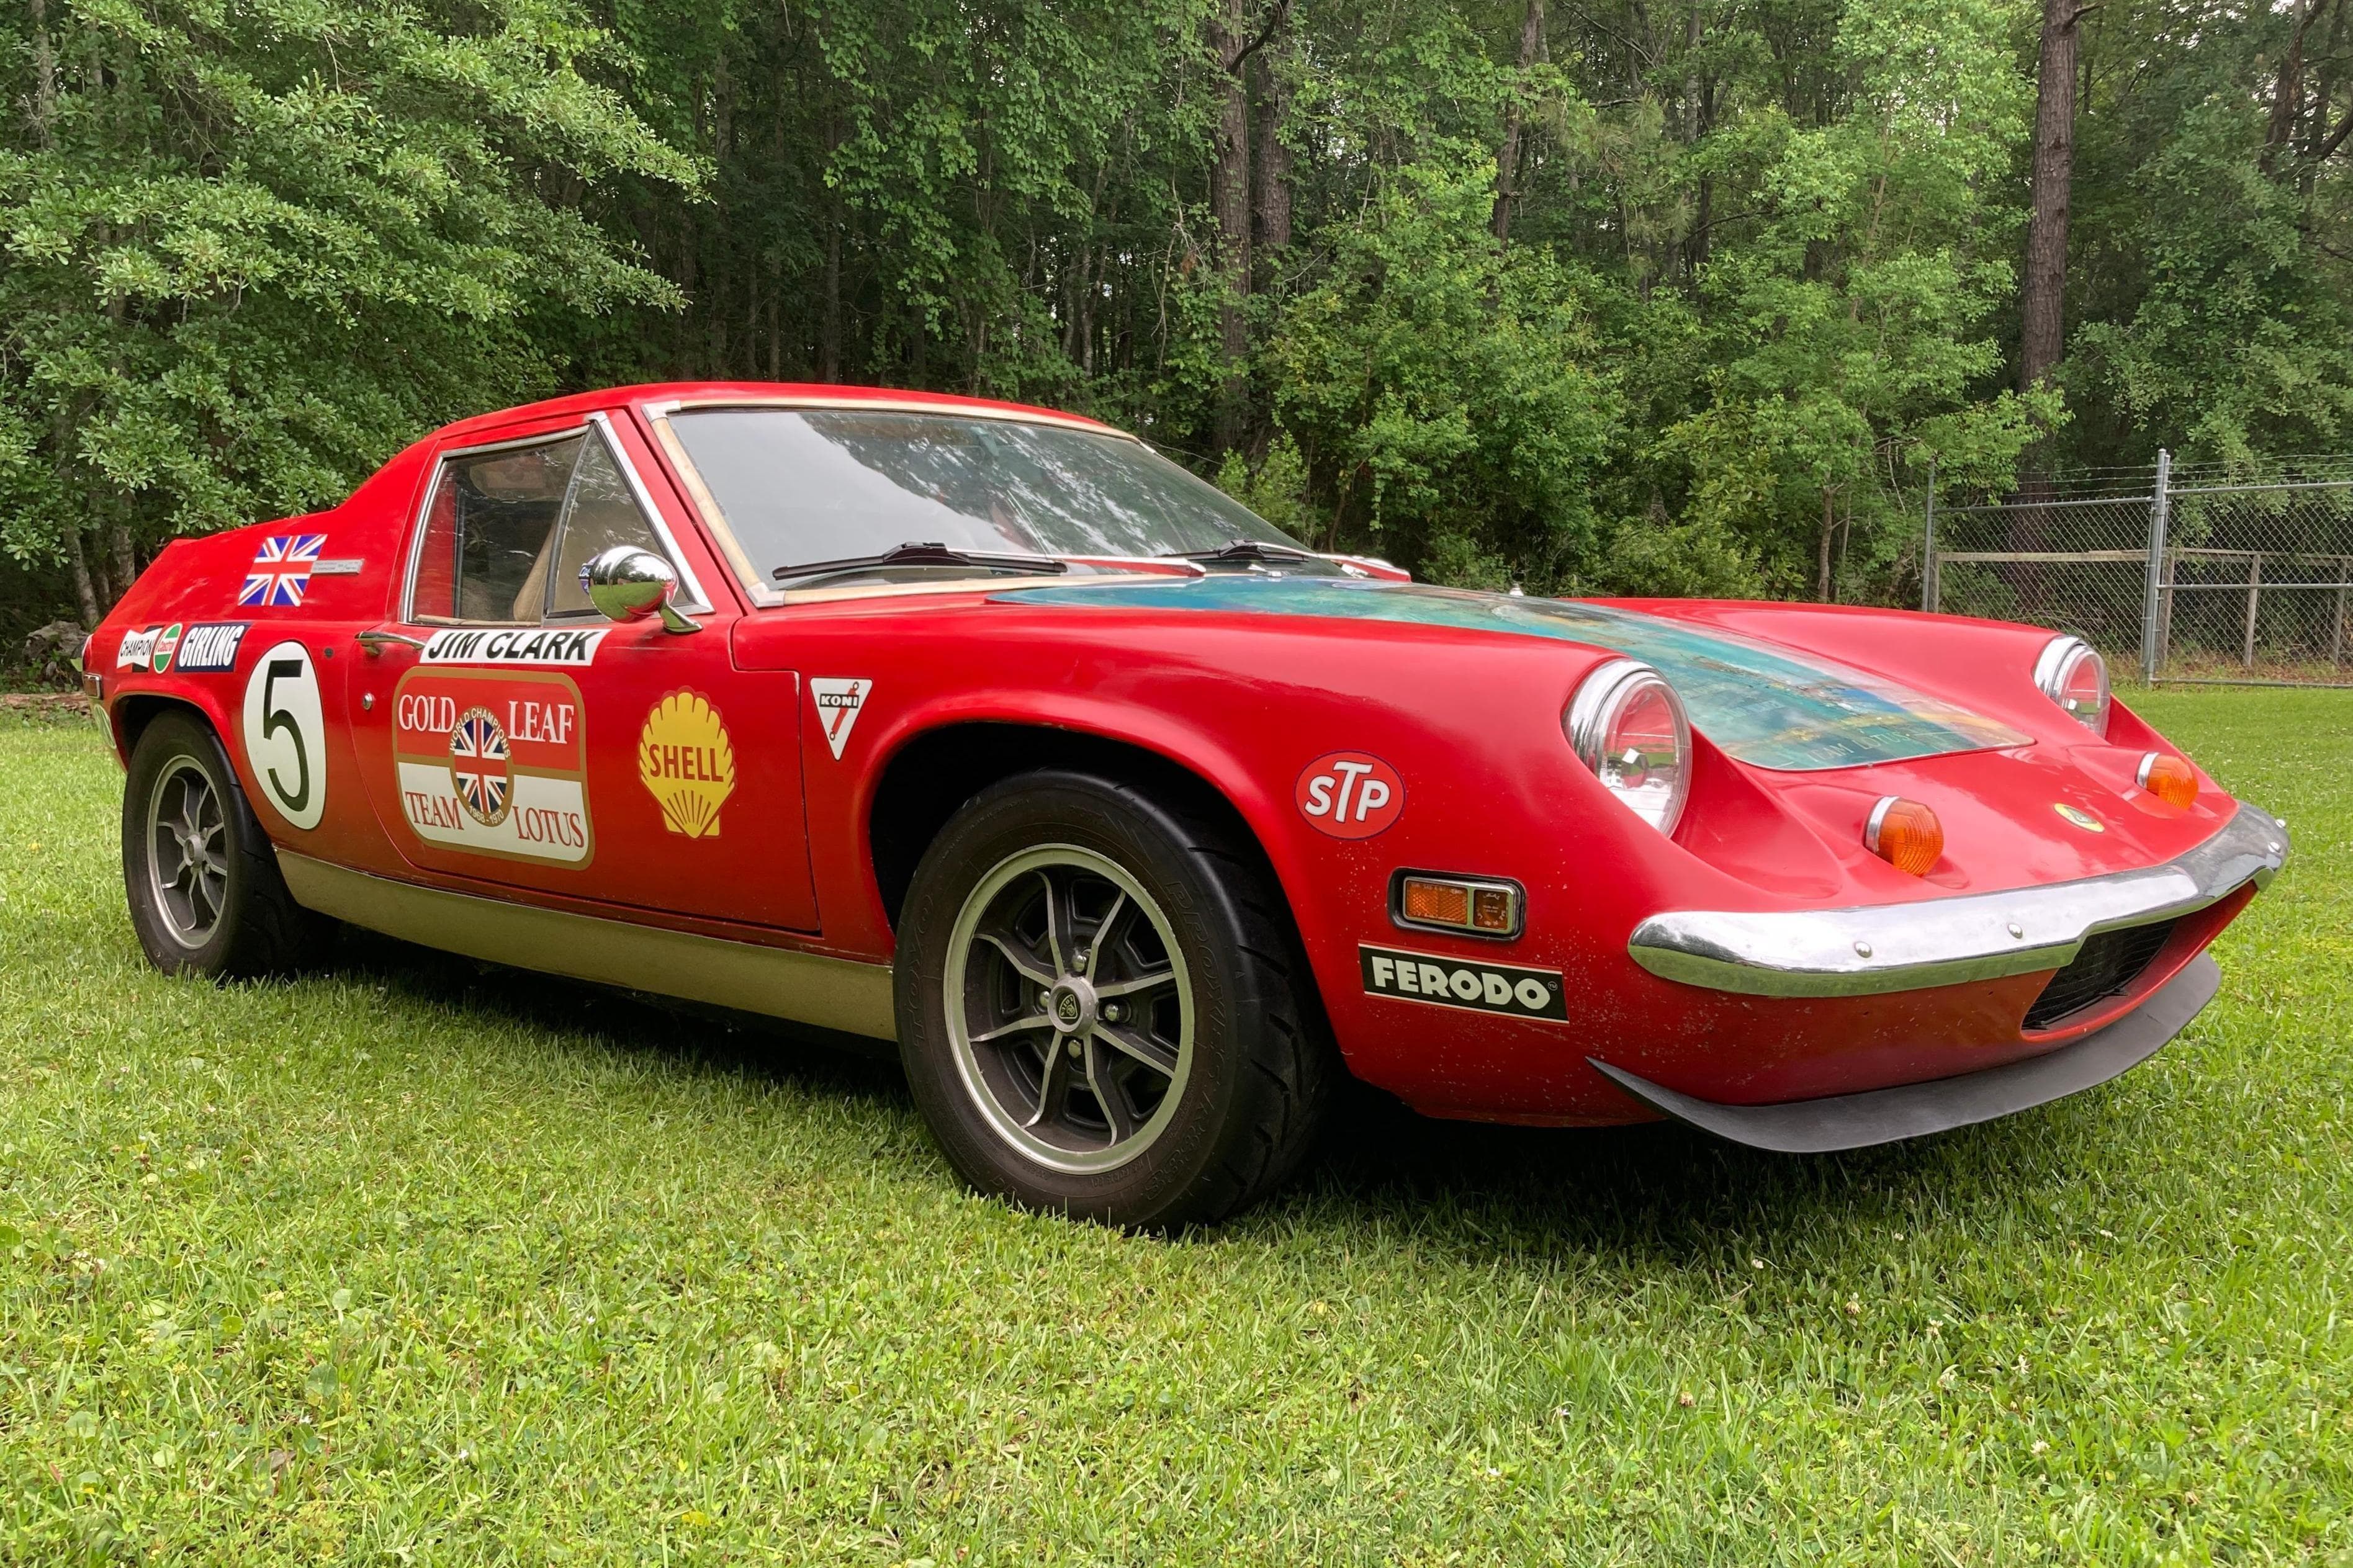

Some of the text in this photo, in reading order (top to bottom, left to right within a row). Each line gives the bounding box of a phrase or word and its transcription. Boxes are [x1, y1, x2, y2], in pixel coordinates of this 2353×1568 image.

[120, 639, 154, 656] CHAMPION
[179, 625, 245, 666] GIRLING
[428, 632, 600, 660] JIM CLARK
[398, 694, 574, 744] GOLD LEAF
[820, 695, 858, 707] KONI
[263, 660, 309, 812] 5
[449, 707, 511, 758] WORLD CHAMPIONS
[649, 743, 724, 782] SHELL
[1304, 760, 1390, 823] STP
[405, 792, 585, 848] TEAM LOTUS
[1372, 956, 1550, 1009] FERODO
